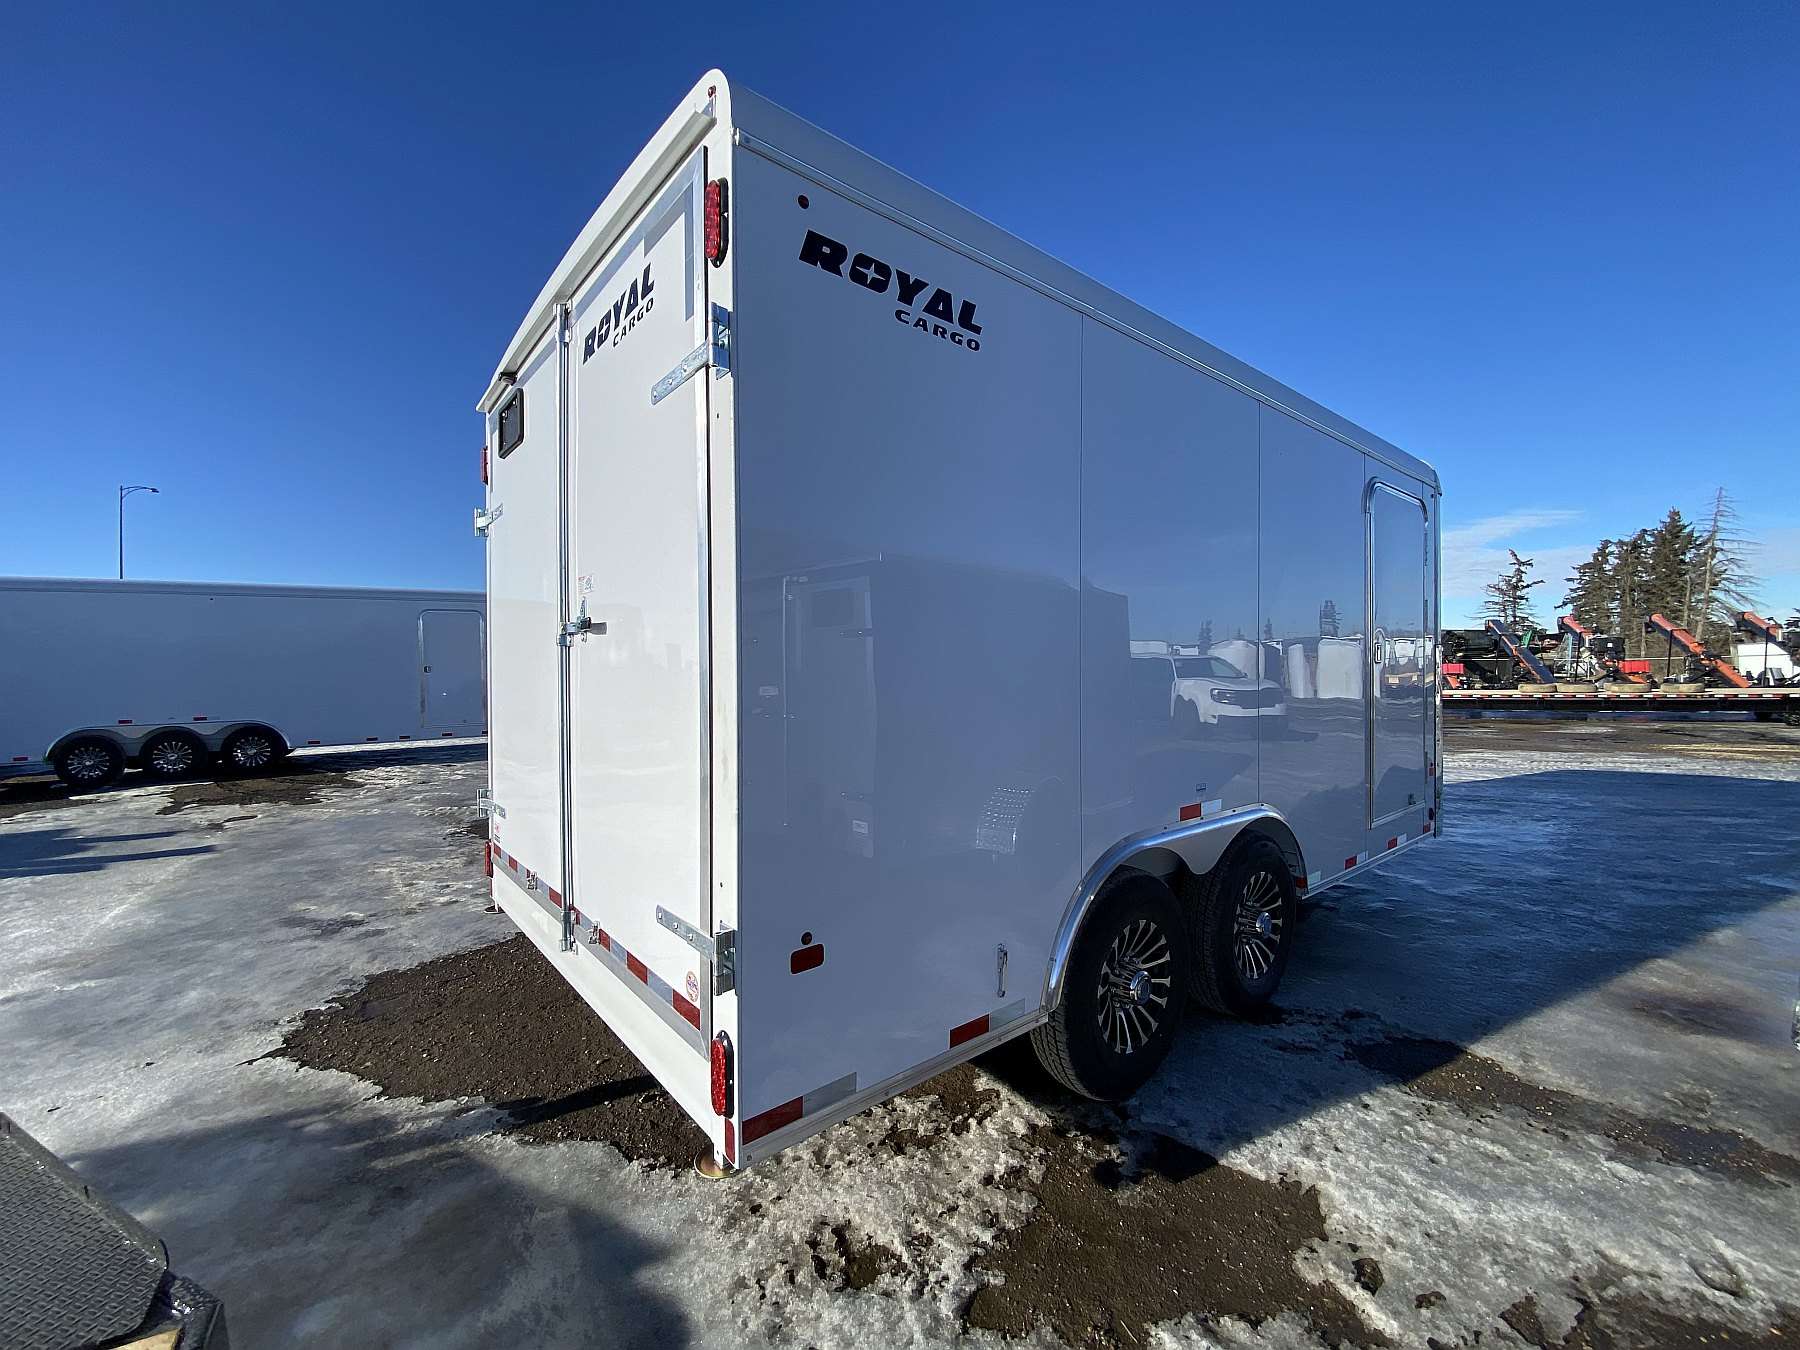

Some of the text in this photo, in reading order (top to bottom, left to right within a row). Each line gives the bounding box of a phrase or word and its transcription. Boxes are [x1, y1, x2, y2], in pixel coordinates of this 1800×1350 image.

[583, 262, 655, 365] ROYAL
[799, 229, 983, 336] ROYAL
[612, 297, 654, 347] CARGO
[894, 309, 981, 352] CARGO
